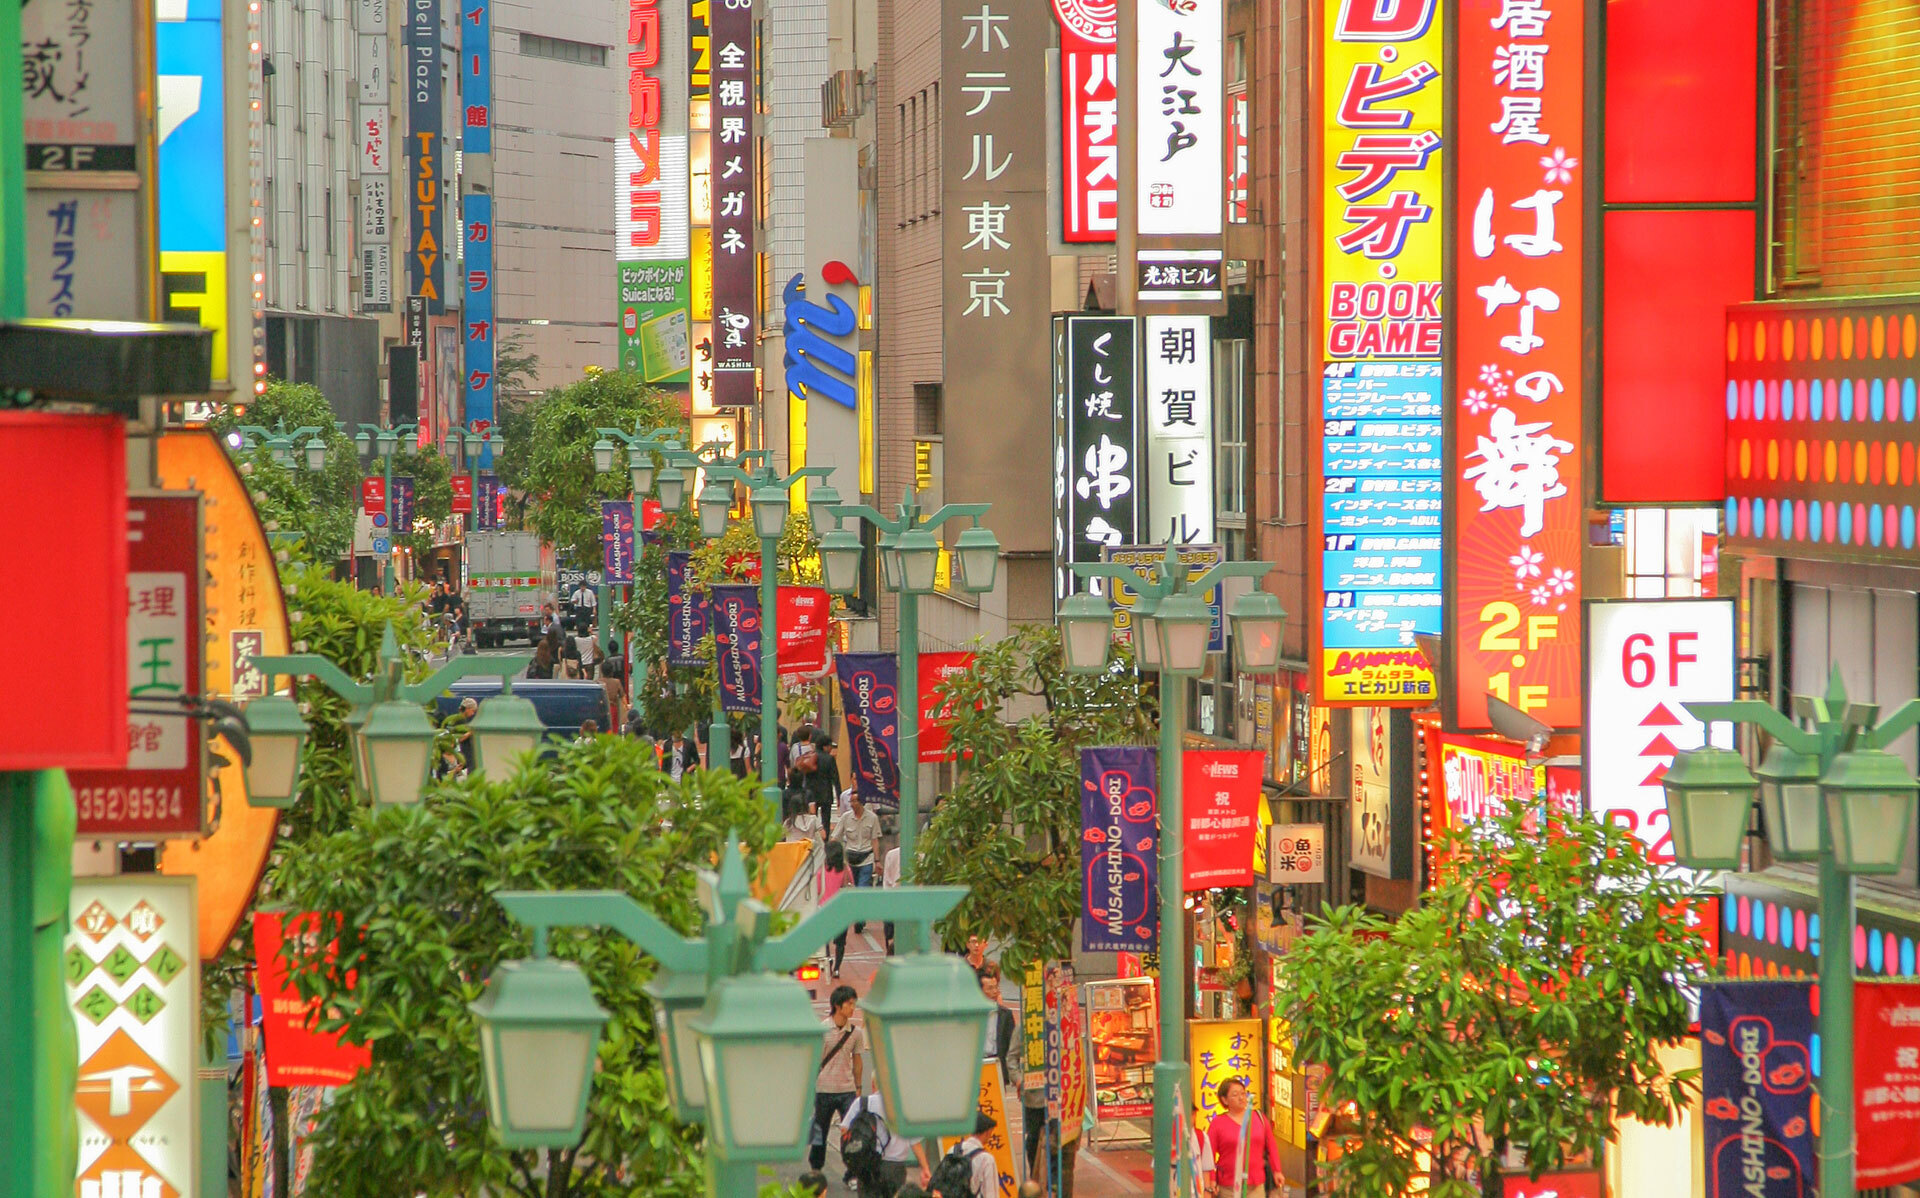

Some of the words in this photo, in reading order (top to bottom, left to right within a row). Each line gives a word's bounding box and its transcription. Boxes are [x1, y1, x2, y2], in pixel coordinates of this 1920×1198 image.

[416, 0, 432, 36] Bell
[416, 47, 433, 103] Plaza
[1490, 0, 1552, 145] 居酒屋
[1159, 31, 1202, 161] 大江戸
[41, 146, 95, 171] 2F
[718, 42, 746, 254] 全視界メガネ
[961, 5, 1013, 316] ホテル東京
[417, 132, 438, 300] TSUTAYA
[379, 245, 388, 276] MAGIC
[622, 267, 684, 284] ビックポイントが
[1328, 281, 1442, 320] BOOK
[1327, 320, 1442, 357] GAME
[1324, 362, 1356, 377] 4F
[1327, 379, 1388, 390] スーパー
[1327, 392, 1432, 403] マニアレーベル
[1160, 328, 1200, 545] 朝賀ビル
[1324, 421, 1356, 436] 3F
[1328, 442, 1432, 453] マニアレーベル
[1325, 478, 1356, 493] 2F
[1326, 535, 1356, 551] 1F
[561, 573, 584, 582] BOSS
[1326, 592, 1353, 608] B1
[1479, 601, 1559, 650] 2F
[729, 602, 745, 702] MUSASHINO-DORI
[1622, 631, 1699, 688] 6F
[1362, 671, 1414, 680] ラムタラ
[858, 677, 888, 794] MUSASHINO-DORI
[1215, 792, 1230, 806] 祝
[1107, 777, 1123, 936] MUSASHINO-DORI
[1294, 838, 1312, 855] 魚
[1280, 855, 1296, 871] 米
